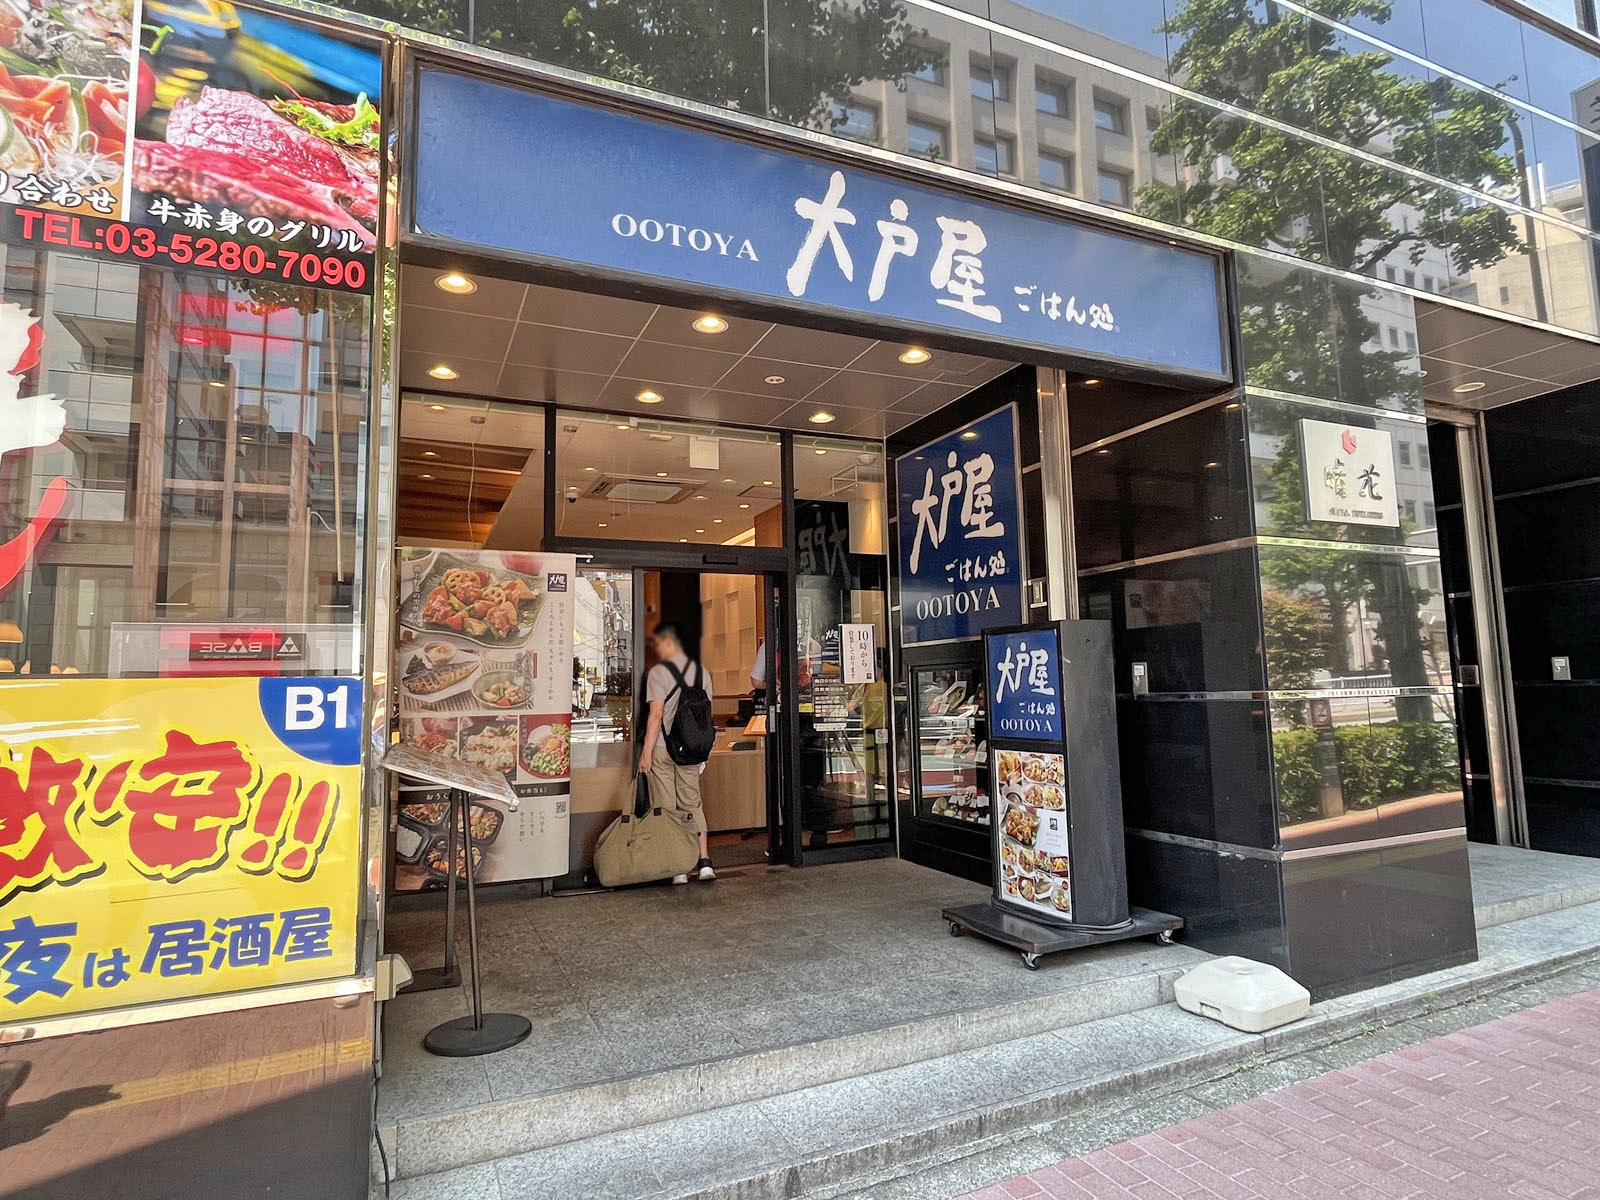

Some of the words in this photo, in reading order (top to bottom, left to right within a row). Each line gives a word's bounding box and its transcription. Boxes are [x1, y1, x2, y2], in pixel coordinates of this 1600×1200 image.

[15, 208, 366, 290] TEL:03-5280-7090
[148, 197, 365, 254] 牛赤身のグリル
[611, 212, 760, 263] OOTOYA
[785, 170, 1002, 324] 大戸屋
[1013, 284, 1116, 333] ごはん処
[910, 450, 1005, 576] 大戸屋
[944, 550, 1007, 583] ごはん処
[915, 585, 1001, 621] OOTOYA
[857, 630, 869, 667] 10時から
[996, 642, 1055, 704] 大戸屋
[285, 685, 349, 730] B1
[1000, 718, 1053, 733] OOTOYA
[0, 907, 332, 1004] 夜は居酒屋
